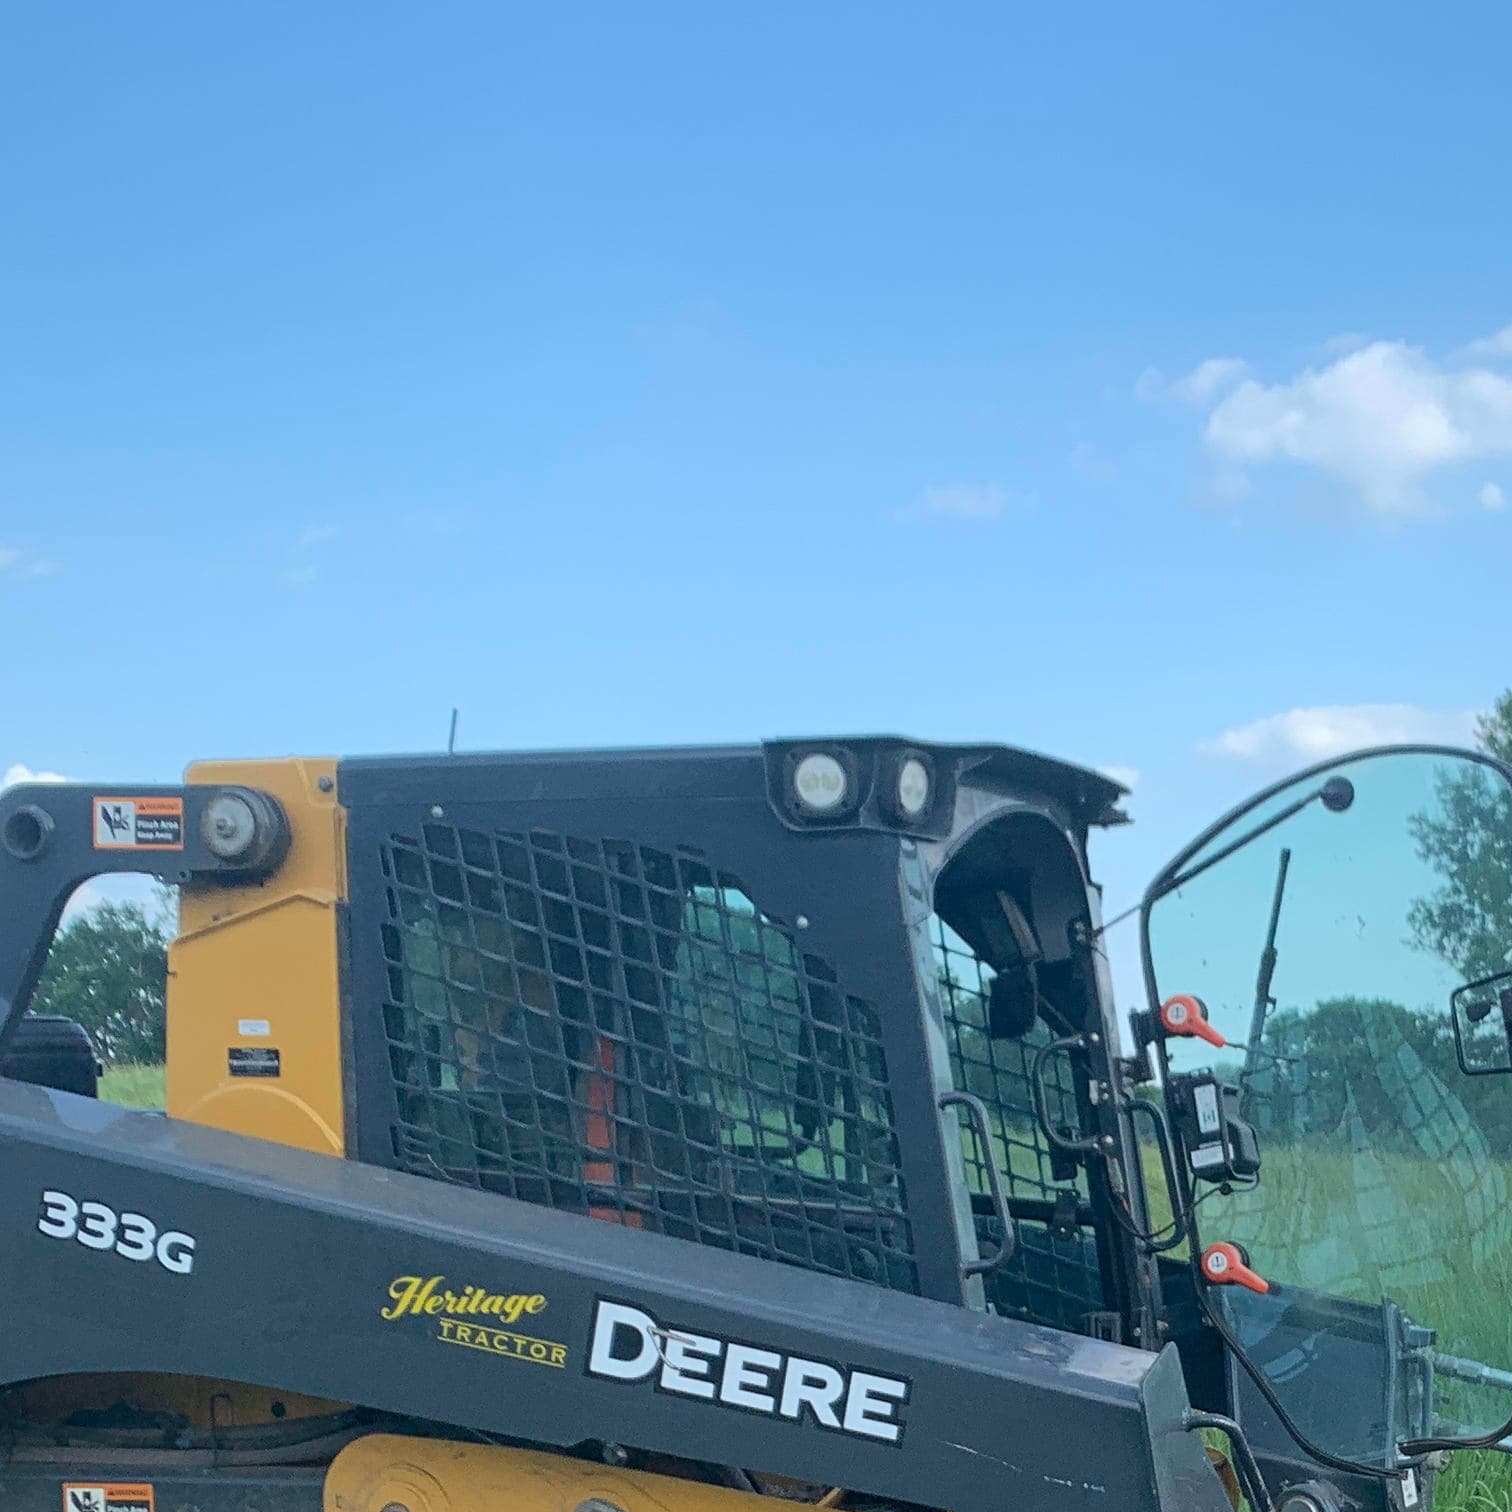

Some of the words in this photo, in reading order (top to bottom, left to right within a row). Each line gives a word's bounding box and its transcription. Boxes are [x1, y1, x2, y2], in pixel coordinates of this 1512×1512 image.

[38, 1190, 197, 1274] 333G
[380, 1275, 548, 1323] Heritage
[439, 1320, 568, 1365] TRACTOR
[589, 1299, 906, 1441] DEERE
